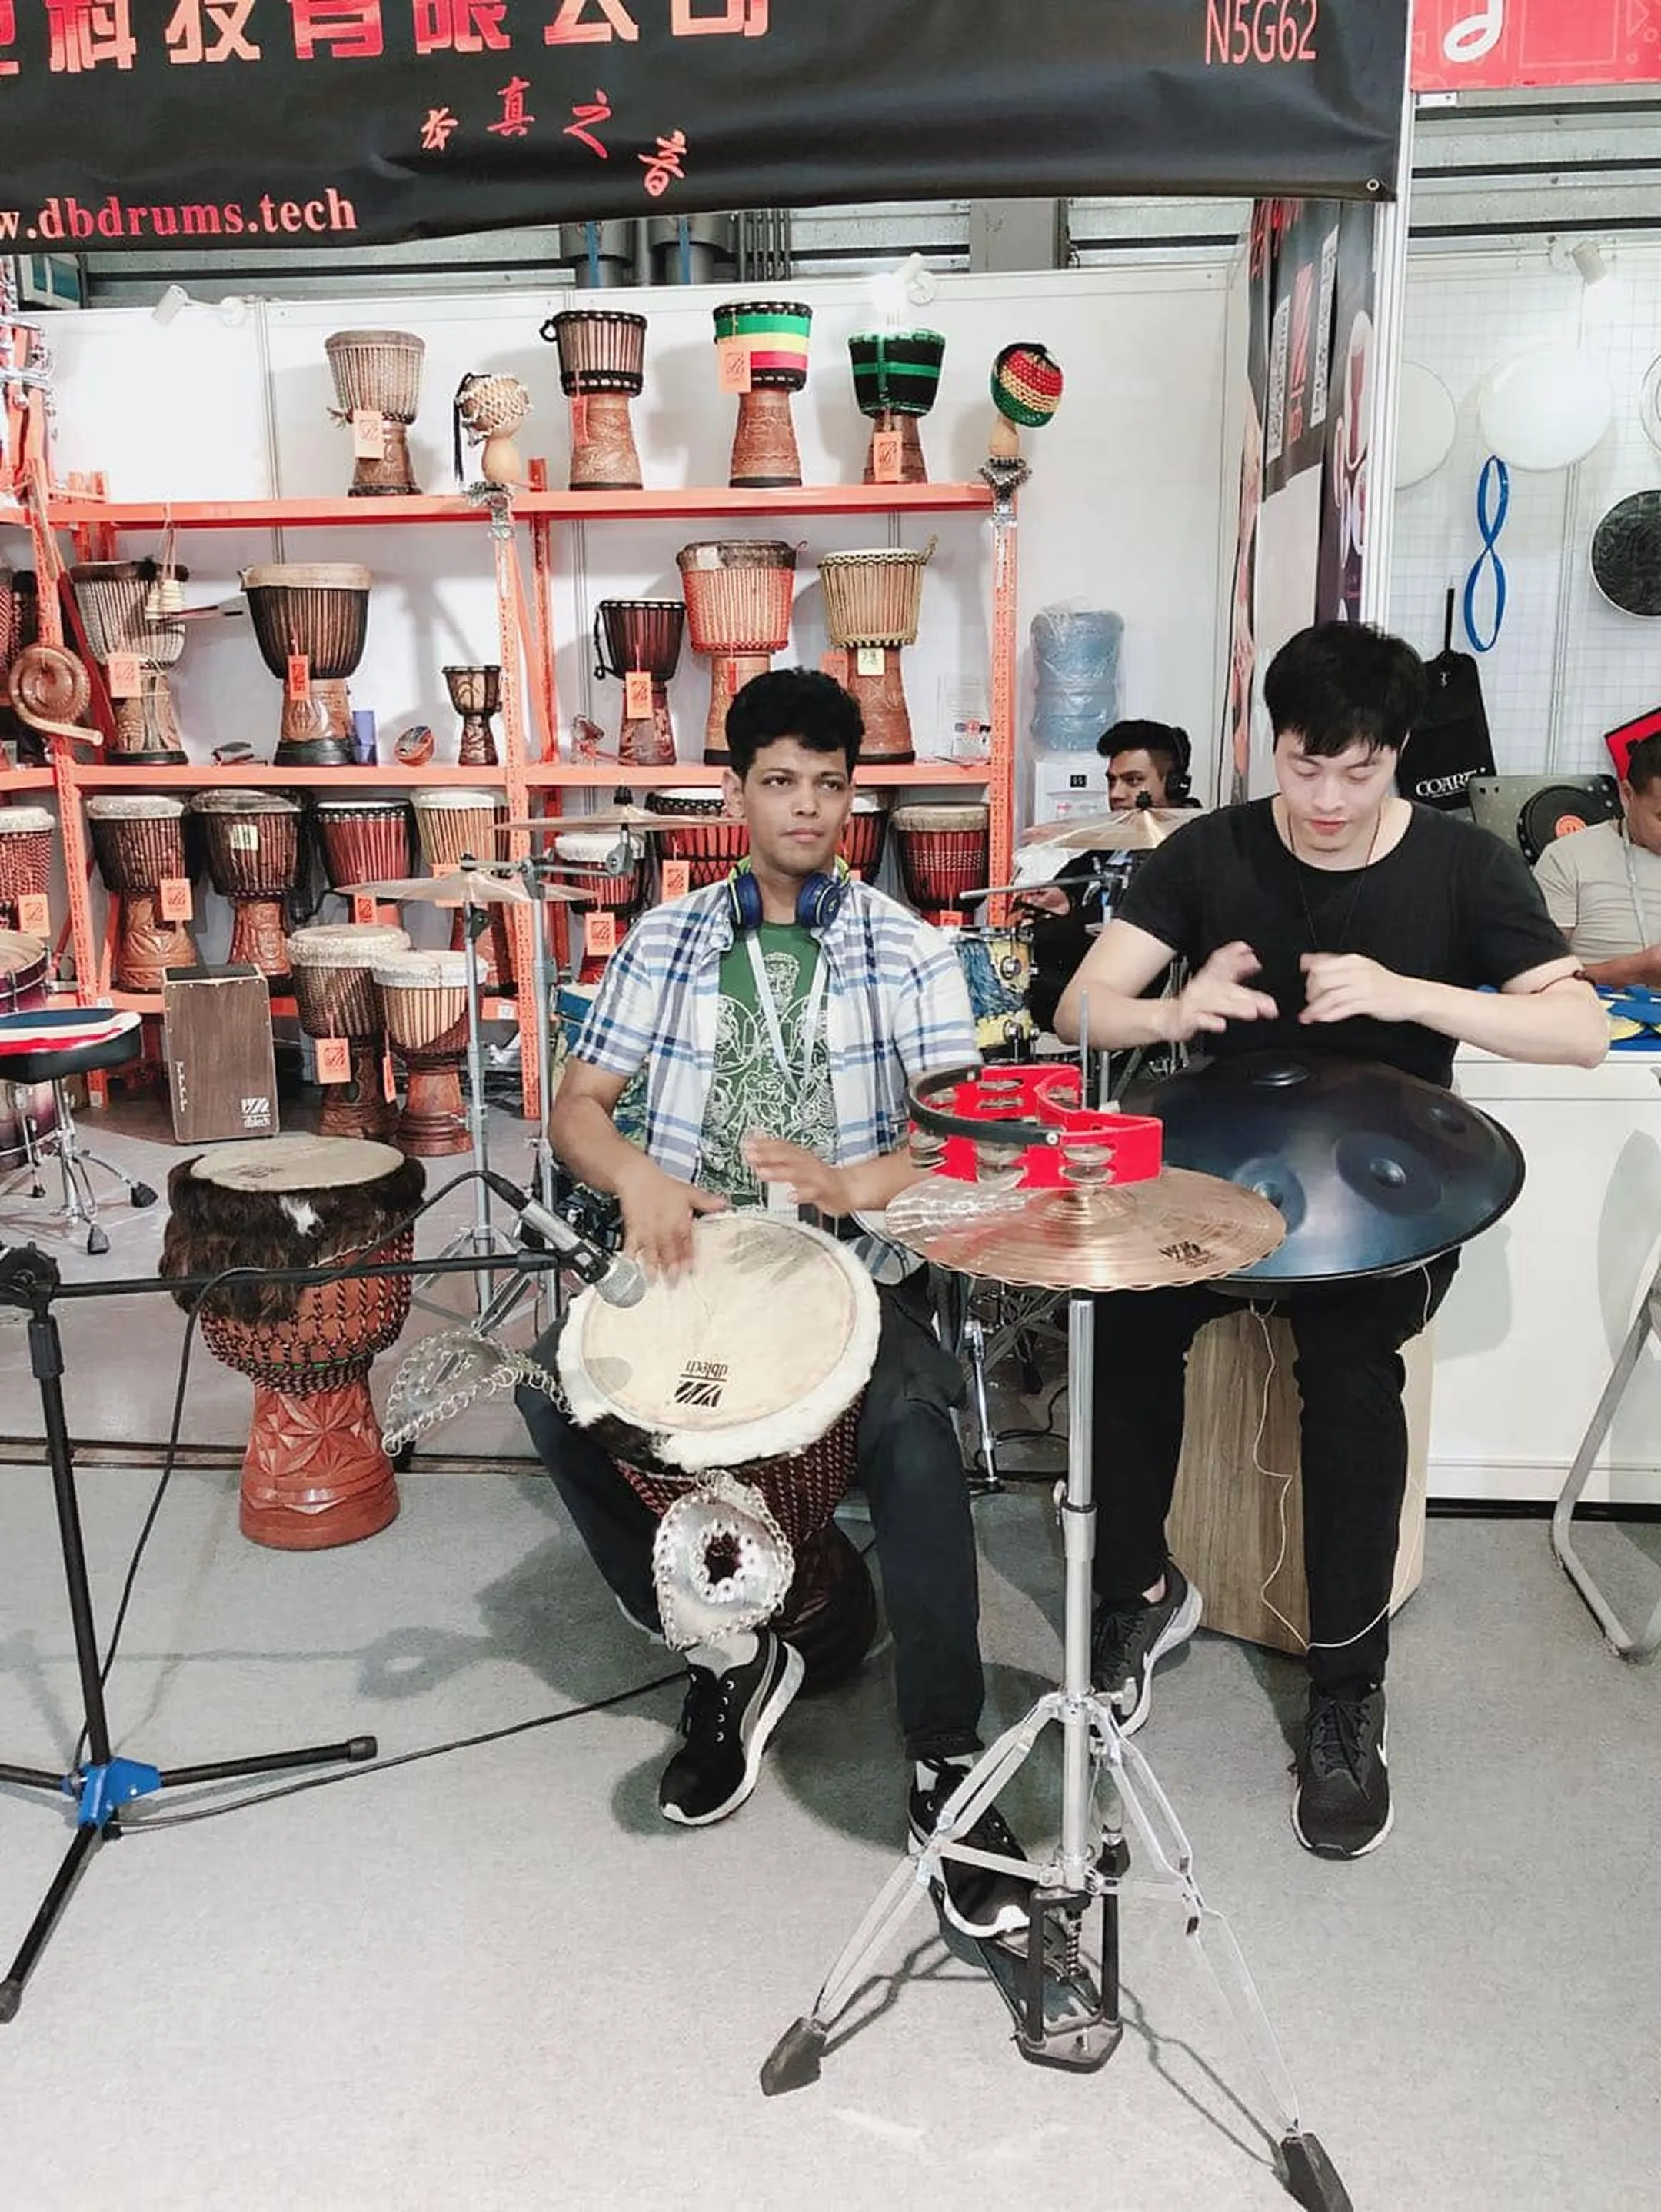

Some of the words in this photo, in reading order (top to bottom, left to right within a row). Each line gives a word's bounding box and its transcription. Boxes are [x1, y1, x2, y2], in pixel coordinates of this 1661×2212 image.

[0, 0, 769, 75] 科技有限
[1206, 0, 1317, 64] N5G62
[686, 1360, 728, 1379] dbtech
